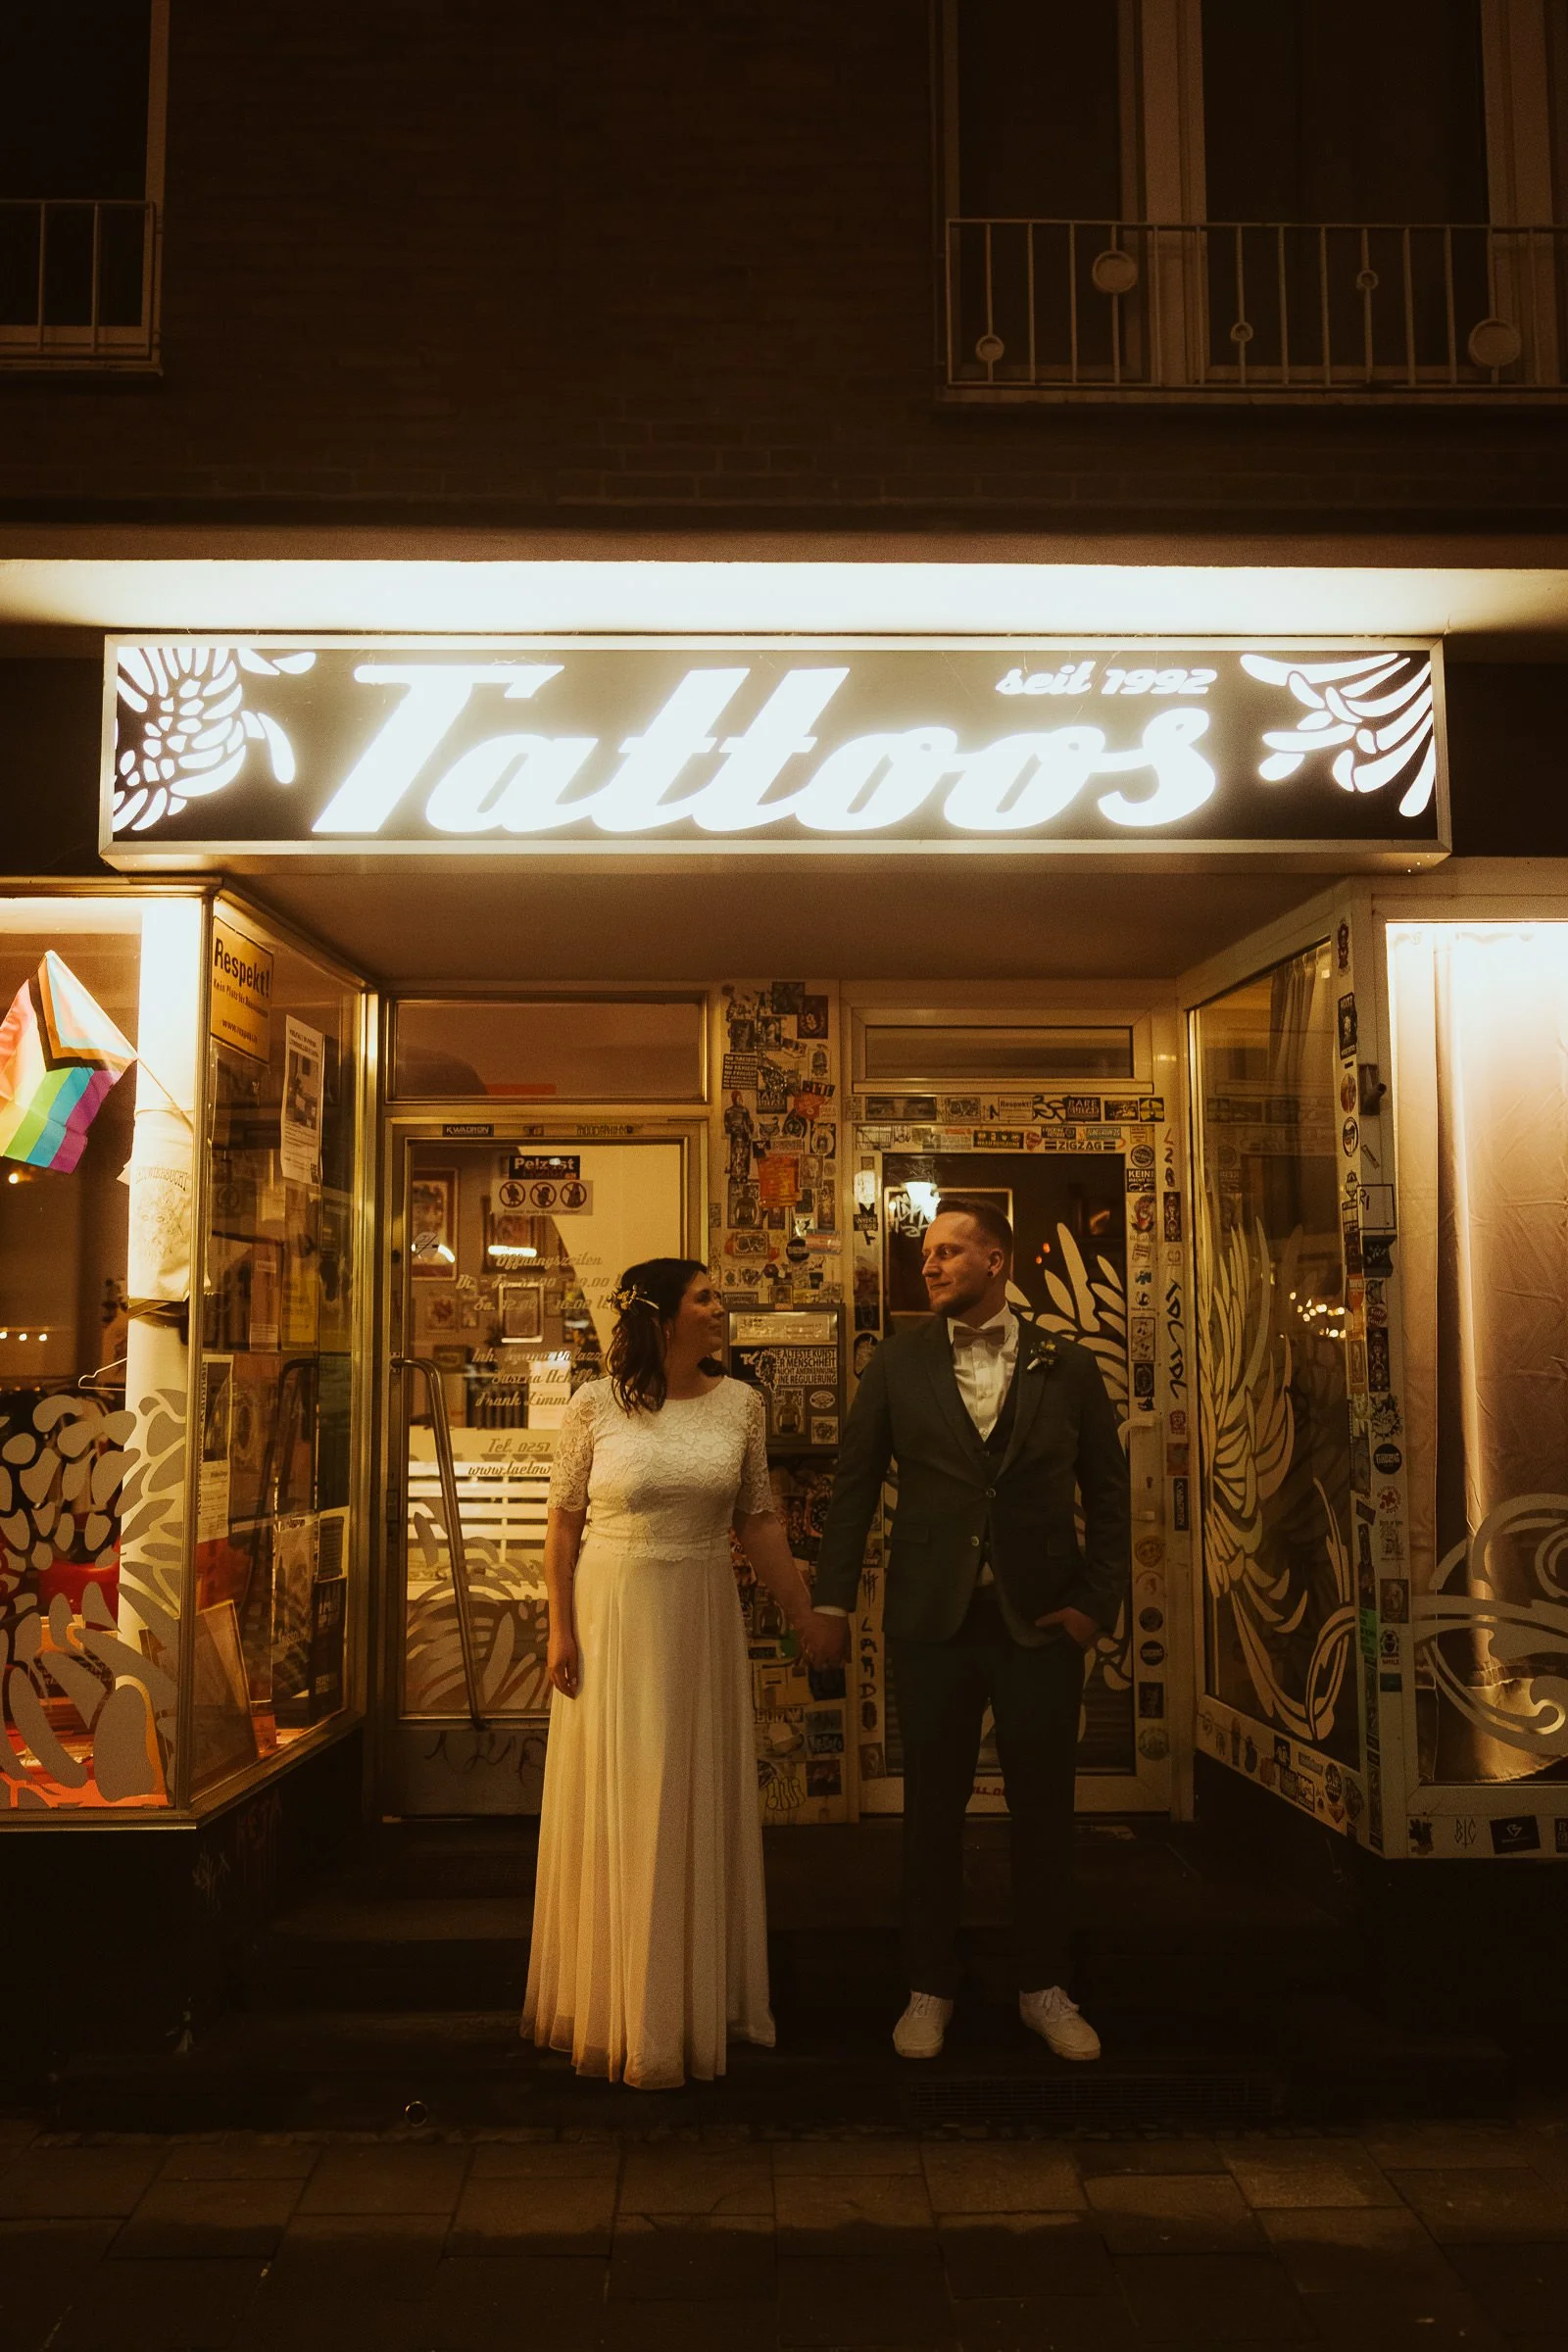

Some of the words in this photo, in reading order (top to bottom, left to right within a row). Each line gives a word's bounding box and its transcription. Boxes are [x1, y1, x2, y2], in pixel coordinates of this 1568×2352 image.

[996, 662, 1096, 695] seit
[1101, 668, 1217, 695] 1992
[312, 664, 1216, 833] Tattoos
[215, 937, 270, 998] Respekt!
[1058, 1141, 1102, 1151] ZIGZAG
[514, 1157, 548, 1171] Pelz
[787, 1358, 836, 1367] MENSCHHEIT
[546, 1369, 604, 1384] Achille
[474, 1391, 521, 1406] Frank
[518, 1442, 551, 1452] 0251
